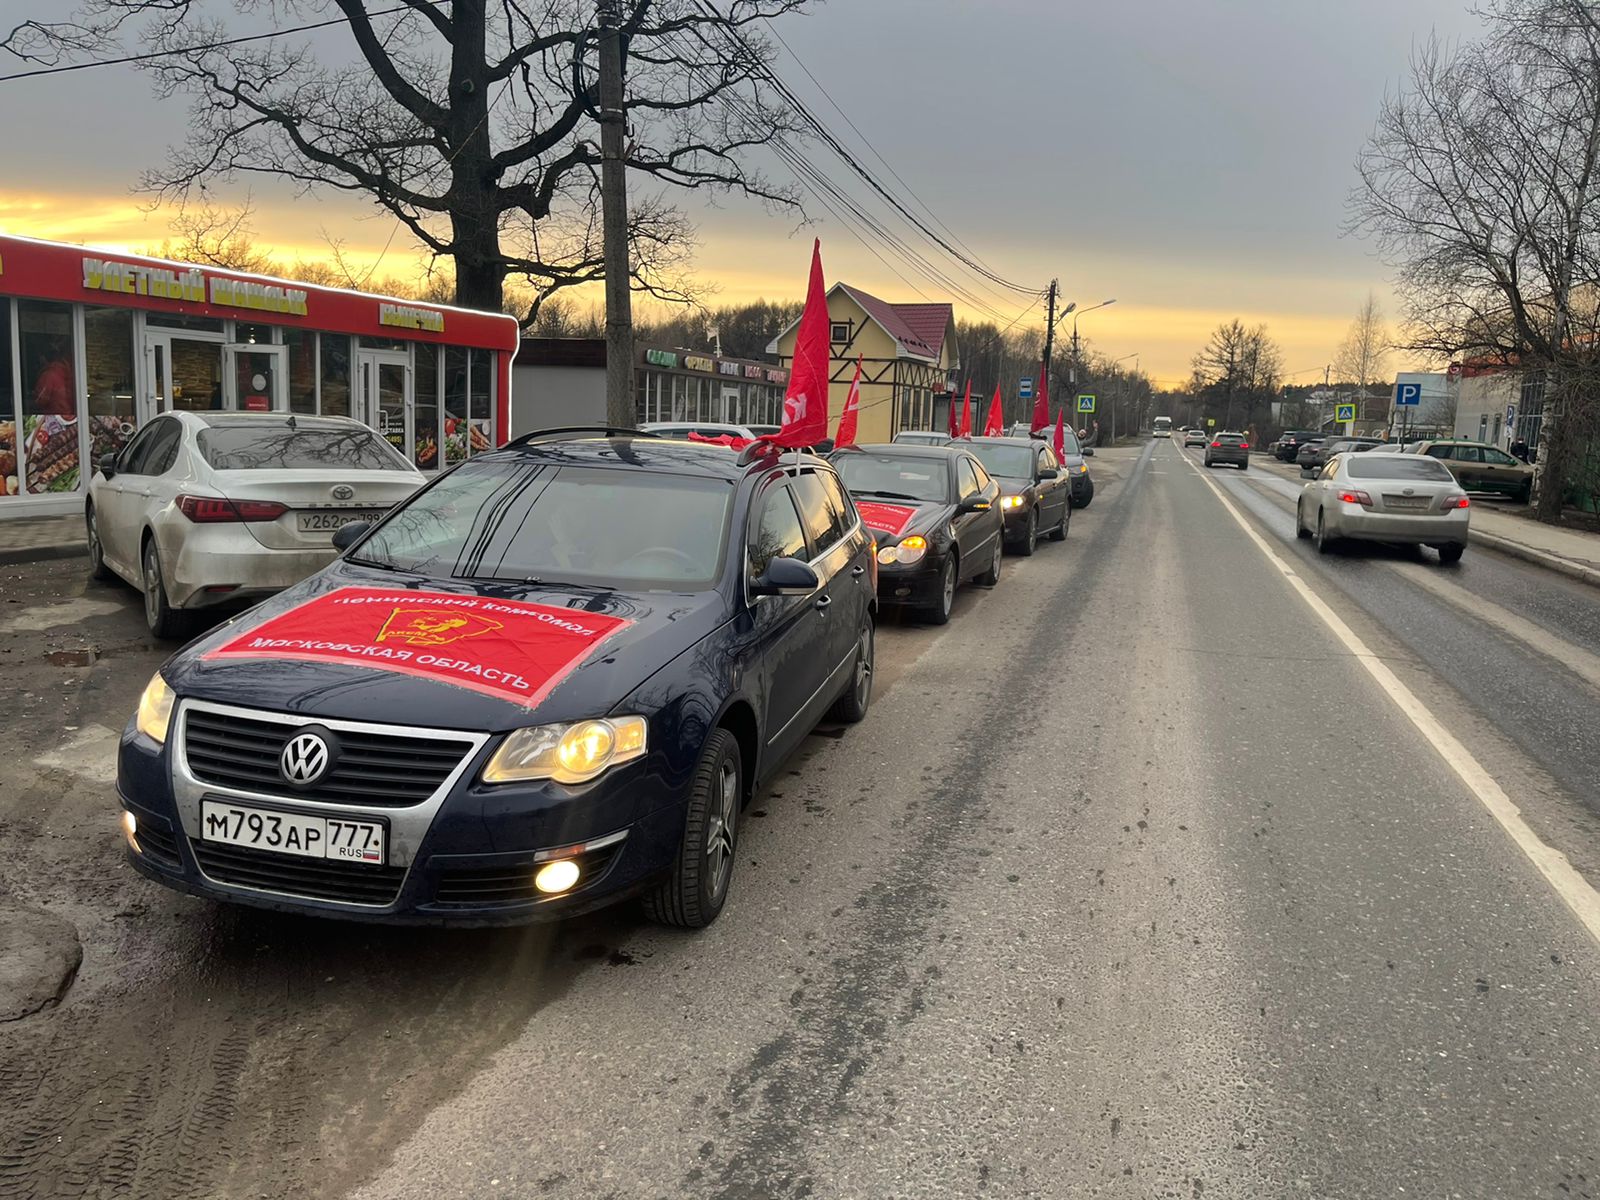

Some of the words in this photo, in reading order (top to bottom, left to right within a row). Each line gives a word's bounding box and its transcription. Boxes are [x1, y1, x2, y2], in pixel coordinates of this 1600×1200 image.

[1402, 386, 1417, 403] P
[248, 637, 414, 661] МОСКОВСКАЯ
[416, 655, 530, 690] ОБЛАСТЬ
[210, 809, 321, 851] М793АР
[328, 821, 375, 849] 777
[339, 847, 362, 858] RUS
